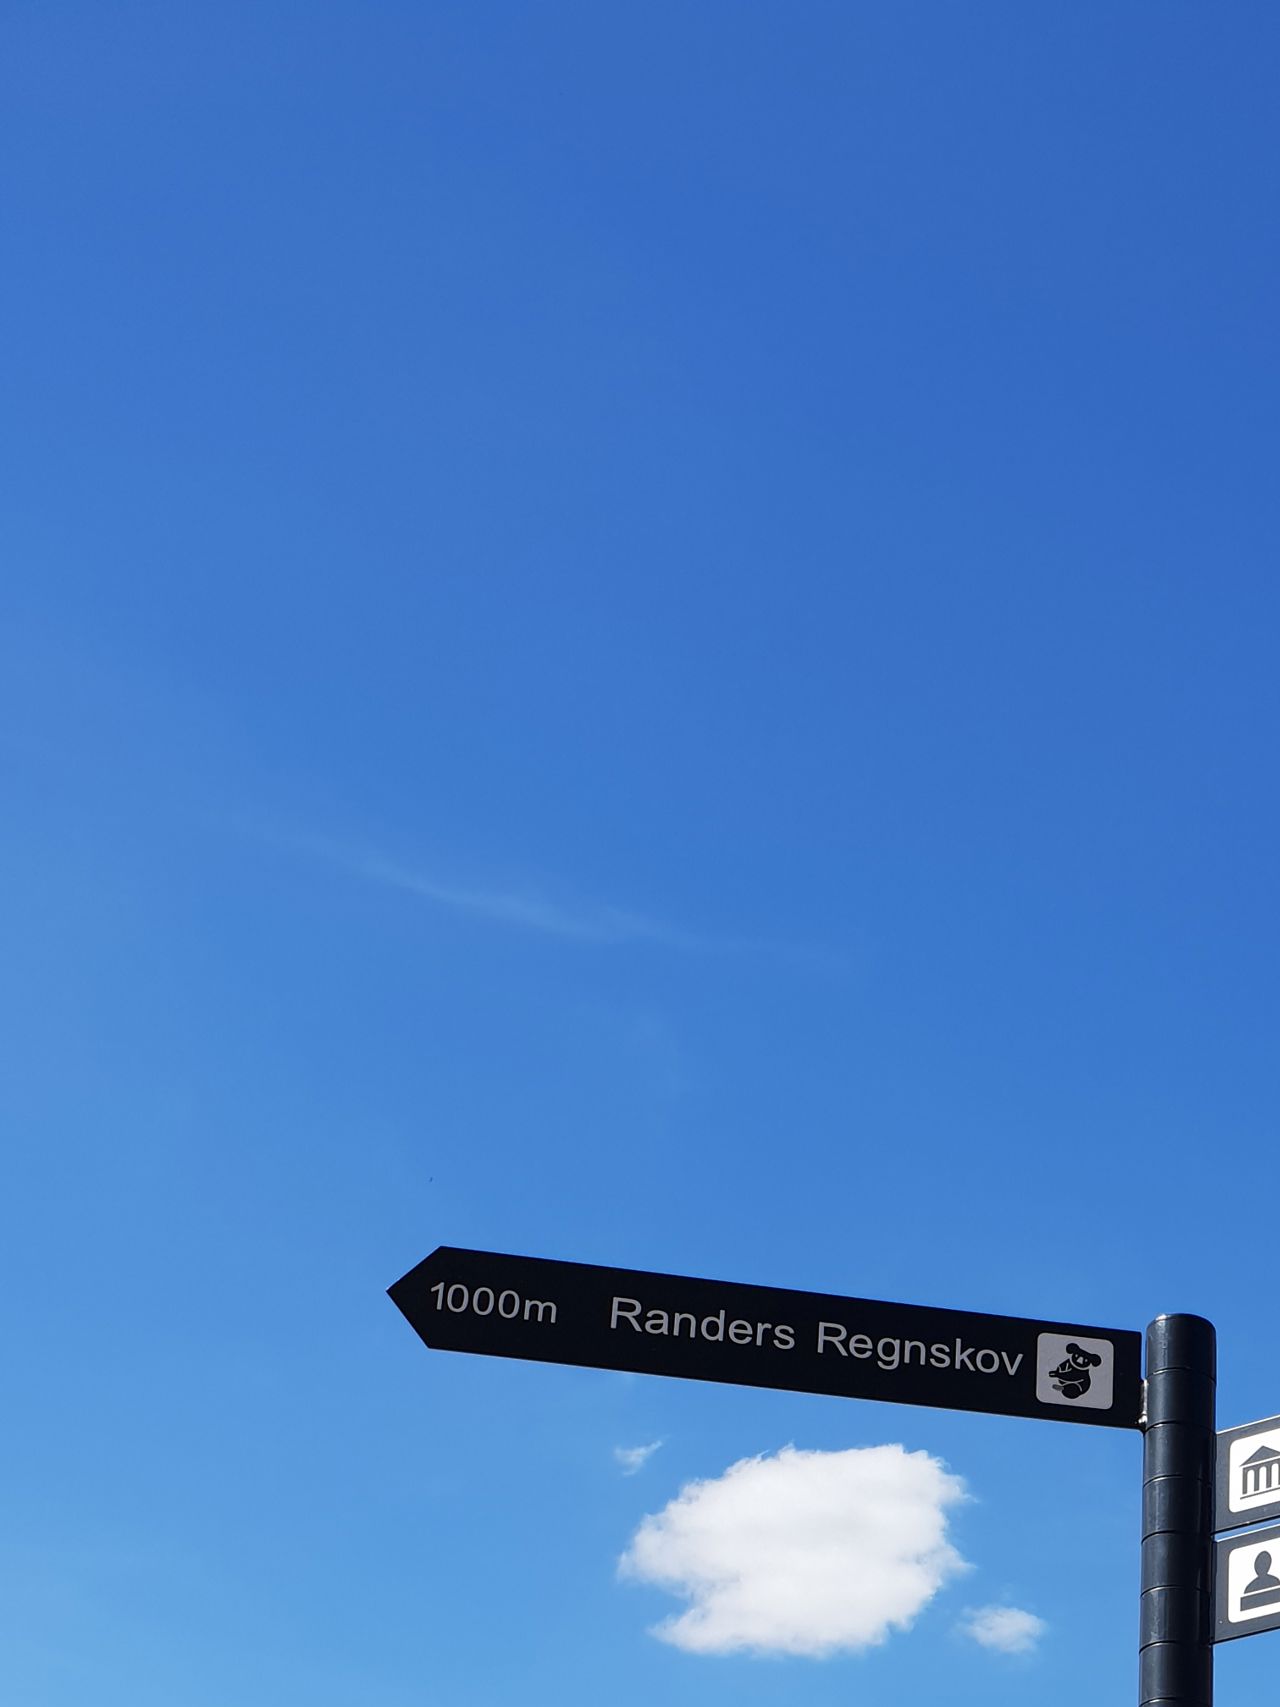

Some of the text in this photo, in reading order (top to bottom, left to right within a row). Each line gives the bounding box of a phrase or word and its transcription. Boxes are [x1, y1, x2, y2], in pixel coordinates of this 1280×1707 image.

[430, 1282, 1025, 1376] 1000m Randers Regnskov
